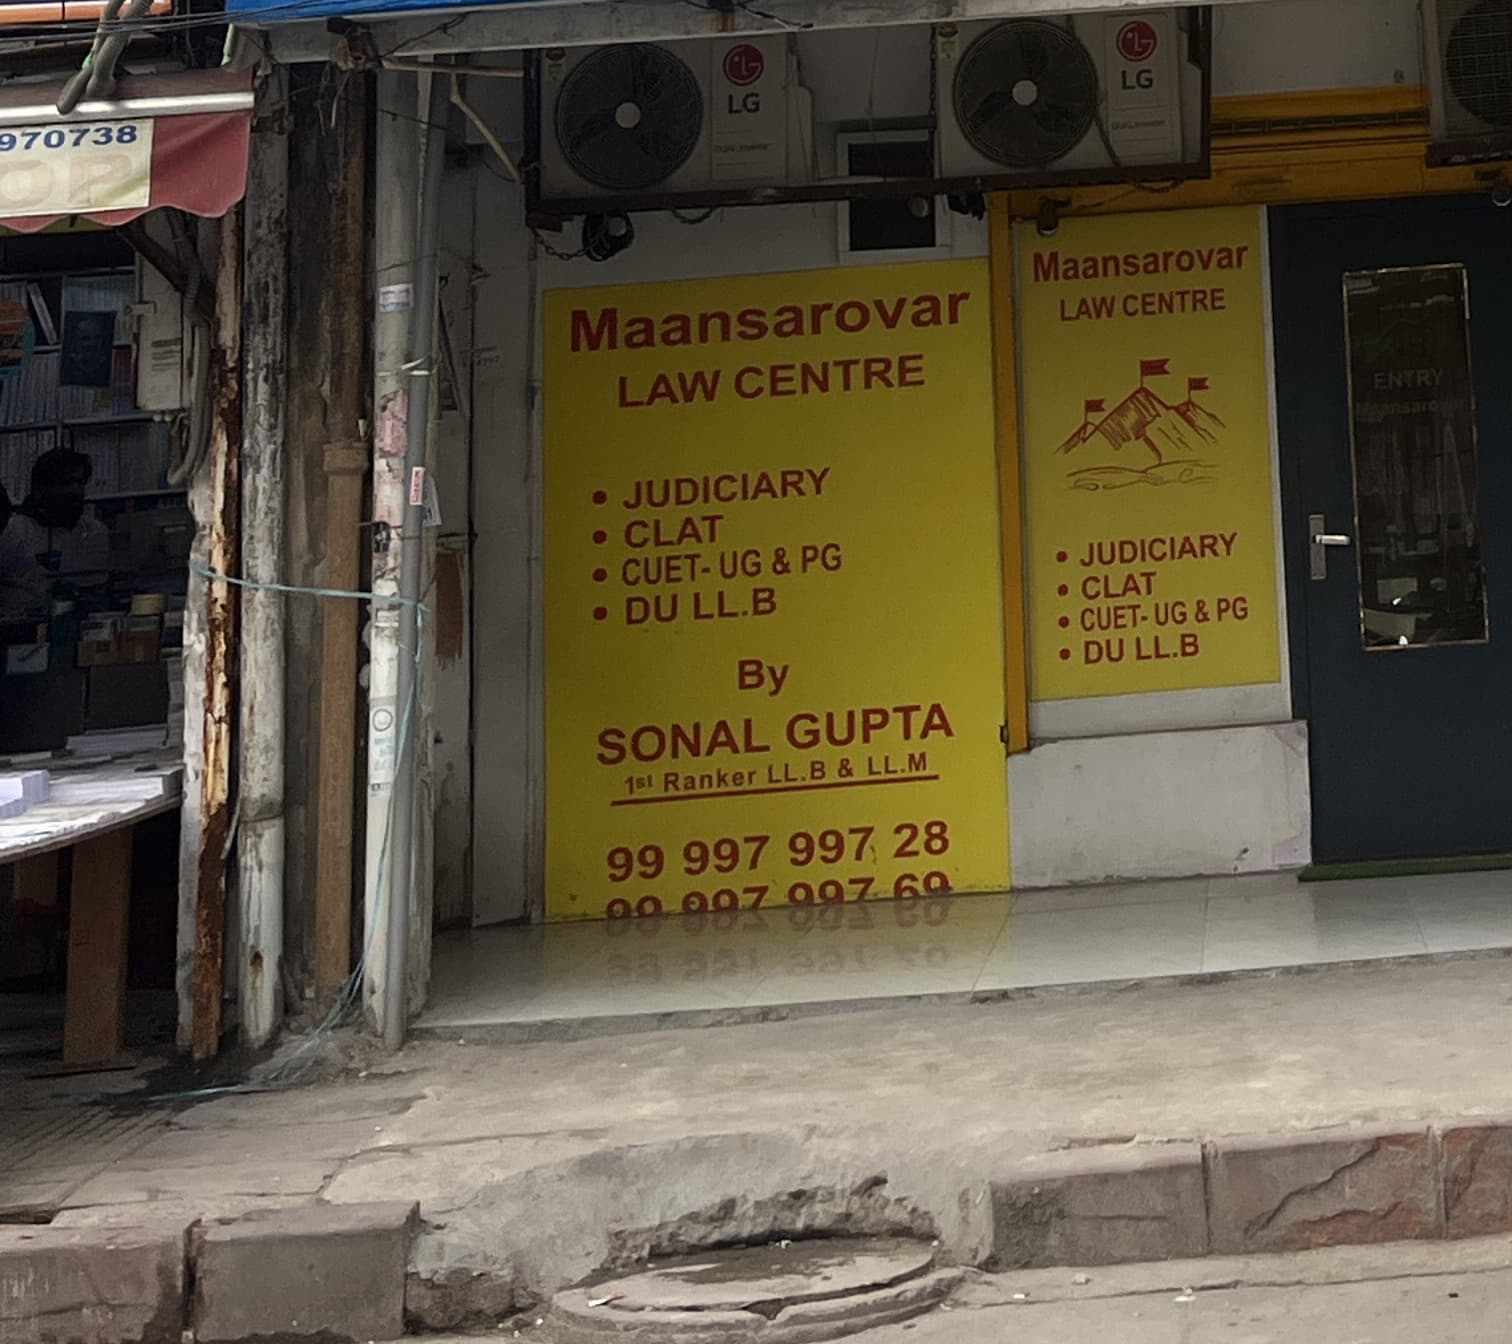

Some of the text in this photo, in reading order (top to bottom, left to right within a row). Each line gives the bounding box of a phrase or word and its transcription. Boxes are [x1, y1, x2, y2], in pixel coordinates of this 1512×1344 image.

[1120, 68, 1155, 90] LG
[727, 94, 761, 115] LG
[1032, 245, 1249, 283] Maansarovar
[570, 291, 972, 354] Maansarovar
[1059, 288, 1226, 322] LAW CENTRE
[617, 354, 926, 408] LAW CENTRE
[1374, 368, 1443, 390] ENTRY
[623, 467, 831, 510] JUDICIARY
[624, 514, 724, 550] CLAT
[1080, 532, 1238, 567] JUDICIARY
[622, 543, 844, 587] CUET- UG & PG
[1081, 572, 1157, 601] CLAT
[625, 587, 778, 626] DU LL.B
[1155, 597, 1249, 626] UG & PG
[1084, 633, 1200, 665] DU LL.B
[737, 659, 789, 697] By
[596, 704, 955, 767] SONAL GUPTA
[663, 752, 928, 794] Ranker LL.B LL.M
[607, 820, 951, 884] 99 997 997 28
